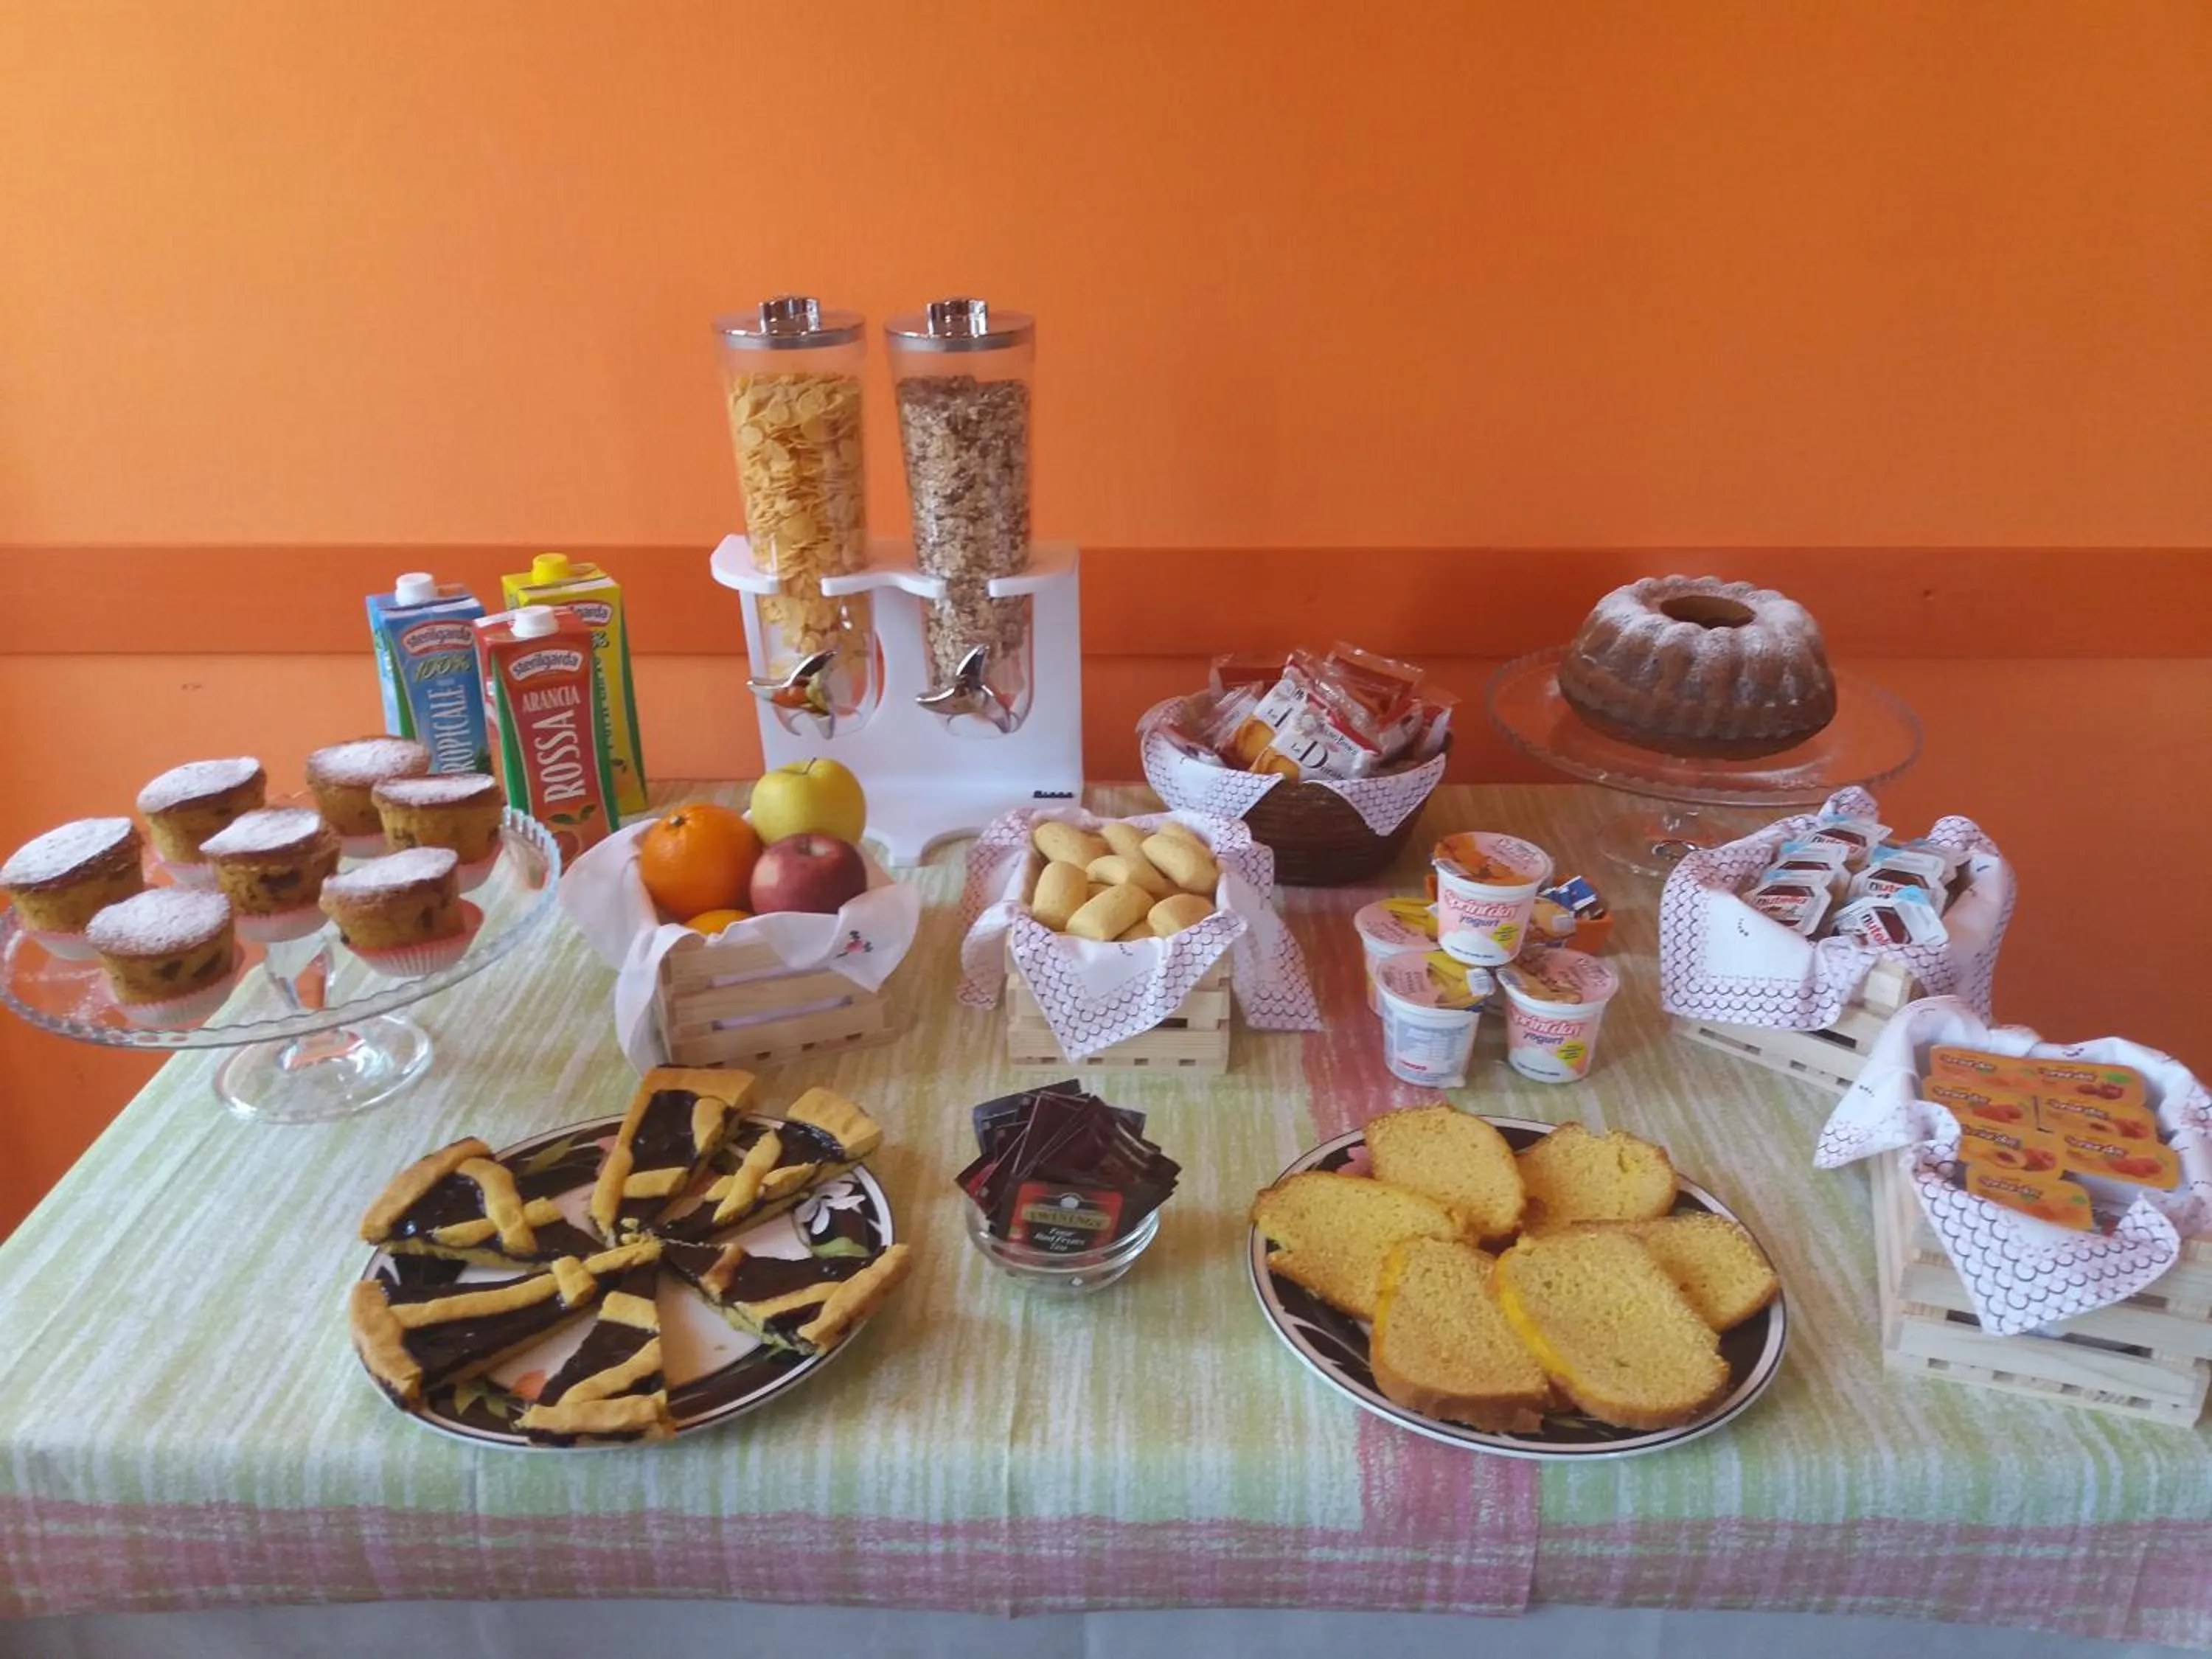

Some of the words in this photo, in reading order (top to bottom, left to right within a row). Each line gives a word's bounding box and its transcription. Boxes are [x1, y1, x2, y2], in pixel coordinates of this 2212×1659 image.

[522, 685, 581, 713] ARANCIA
[427, 684, 476, 774] ROPICALE
[532, 709, 586, 804] ROSSA
[1459, 915, 1500, 928] yogurt
